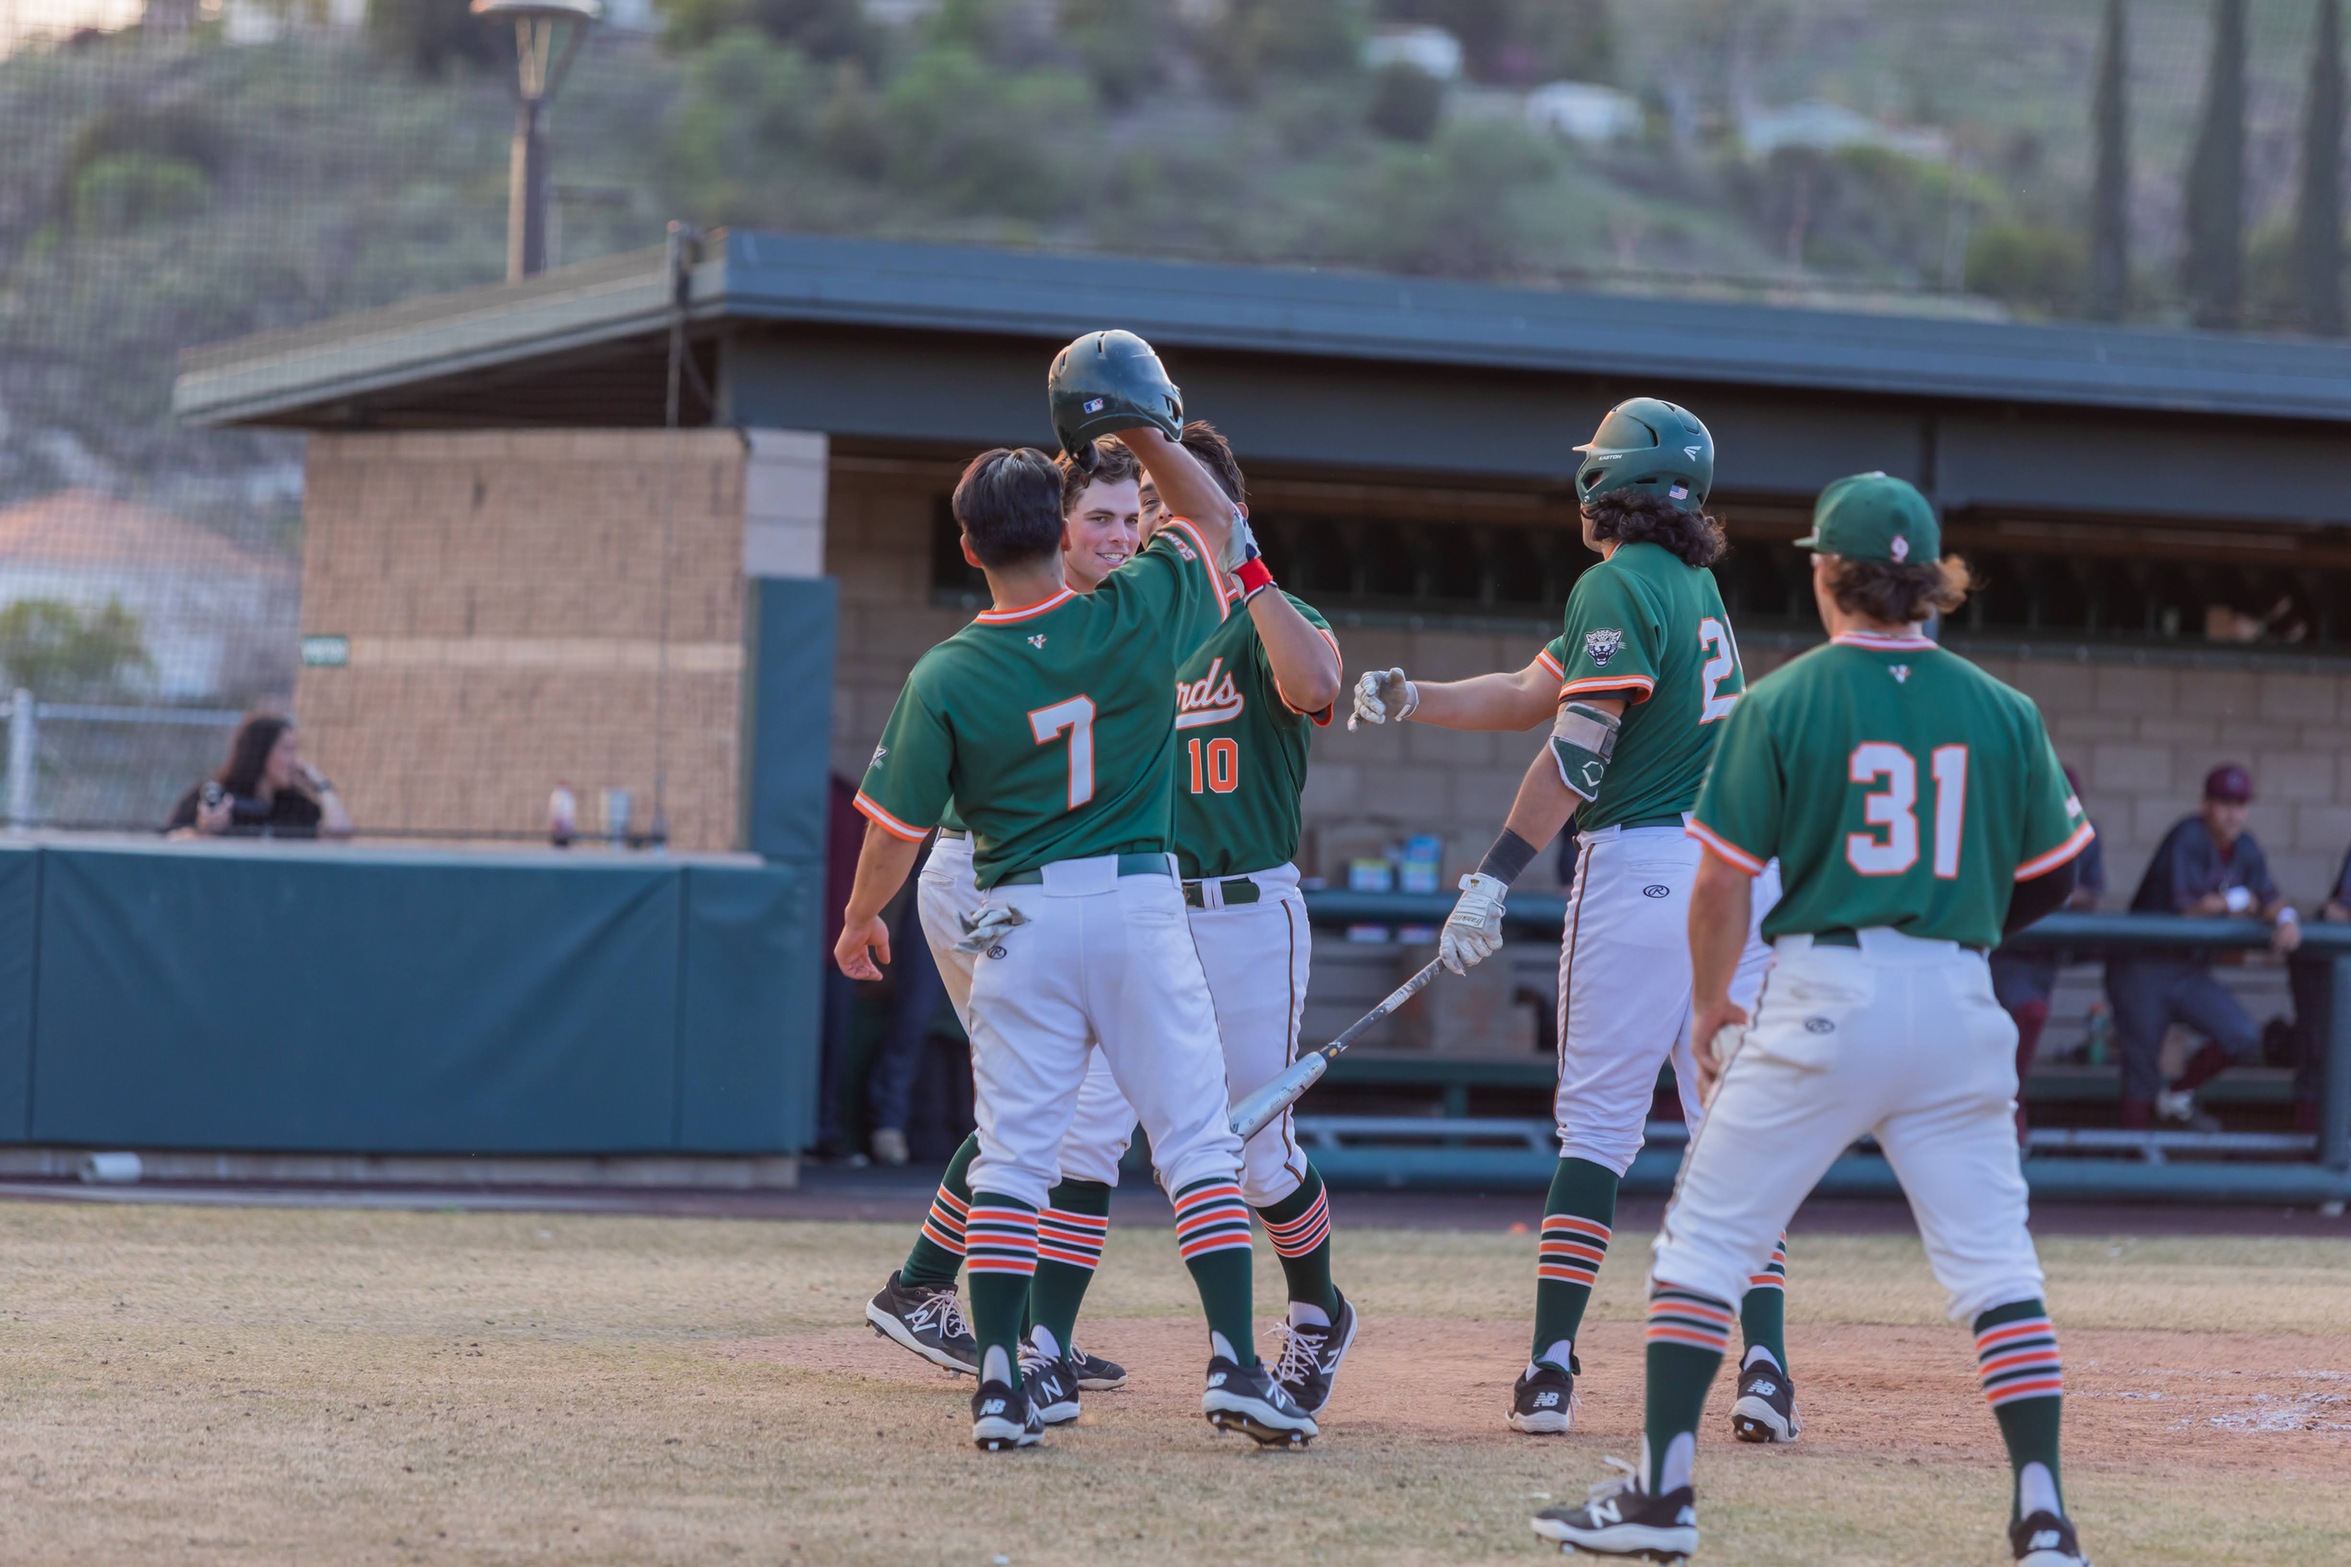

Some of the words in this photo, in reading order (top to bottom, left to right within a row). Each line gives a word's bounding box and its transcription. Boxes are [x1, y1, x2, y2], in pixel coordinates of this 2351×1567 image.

[1698, 614, 1747, 725] 2
[1027, 693, 1096, 811] 7
[1188, 737, 1239, 794] 10
[1846, 740, 1969, 879] 31
[1041, 1375, 1064, 1403] N
[1533, 1392, 1560, 1407] NB
[1746, 1379, 1777, 1396] NB
[979, 1398, 1007, 1416] NB
[1586, 1499, 1623, 1529] N
